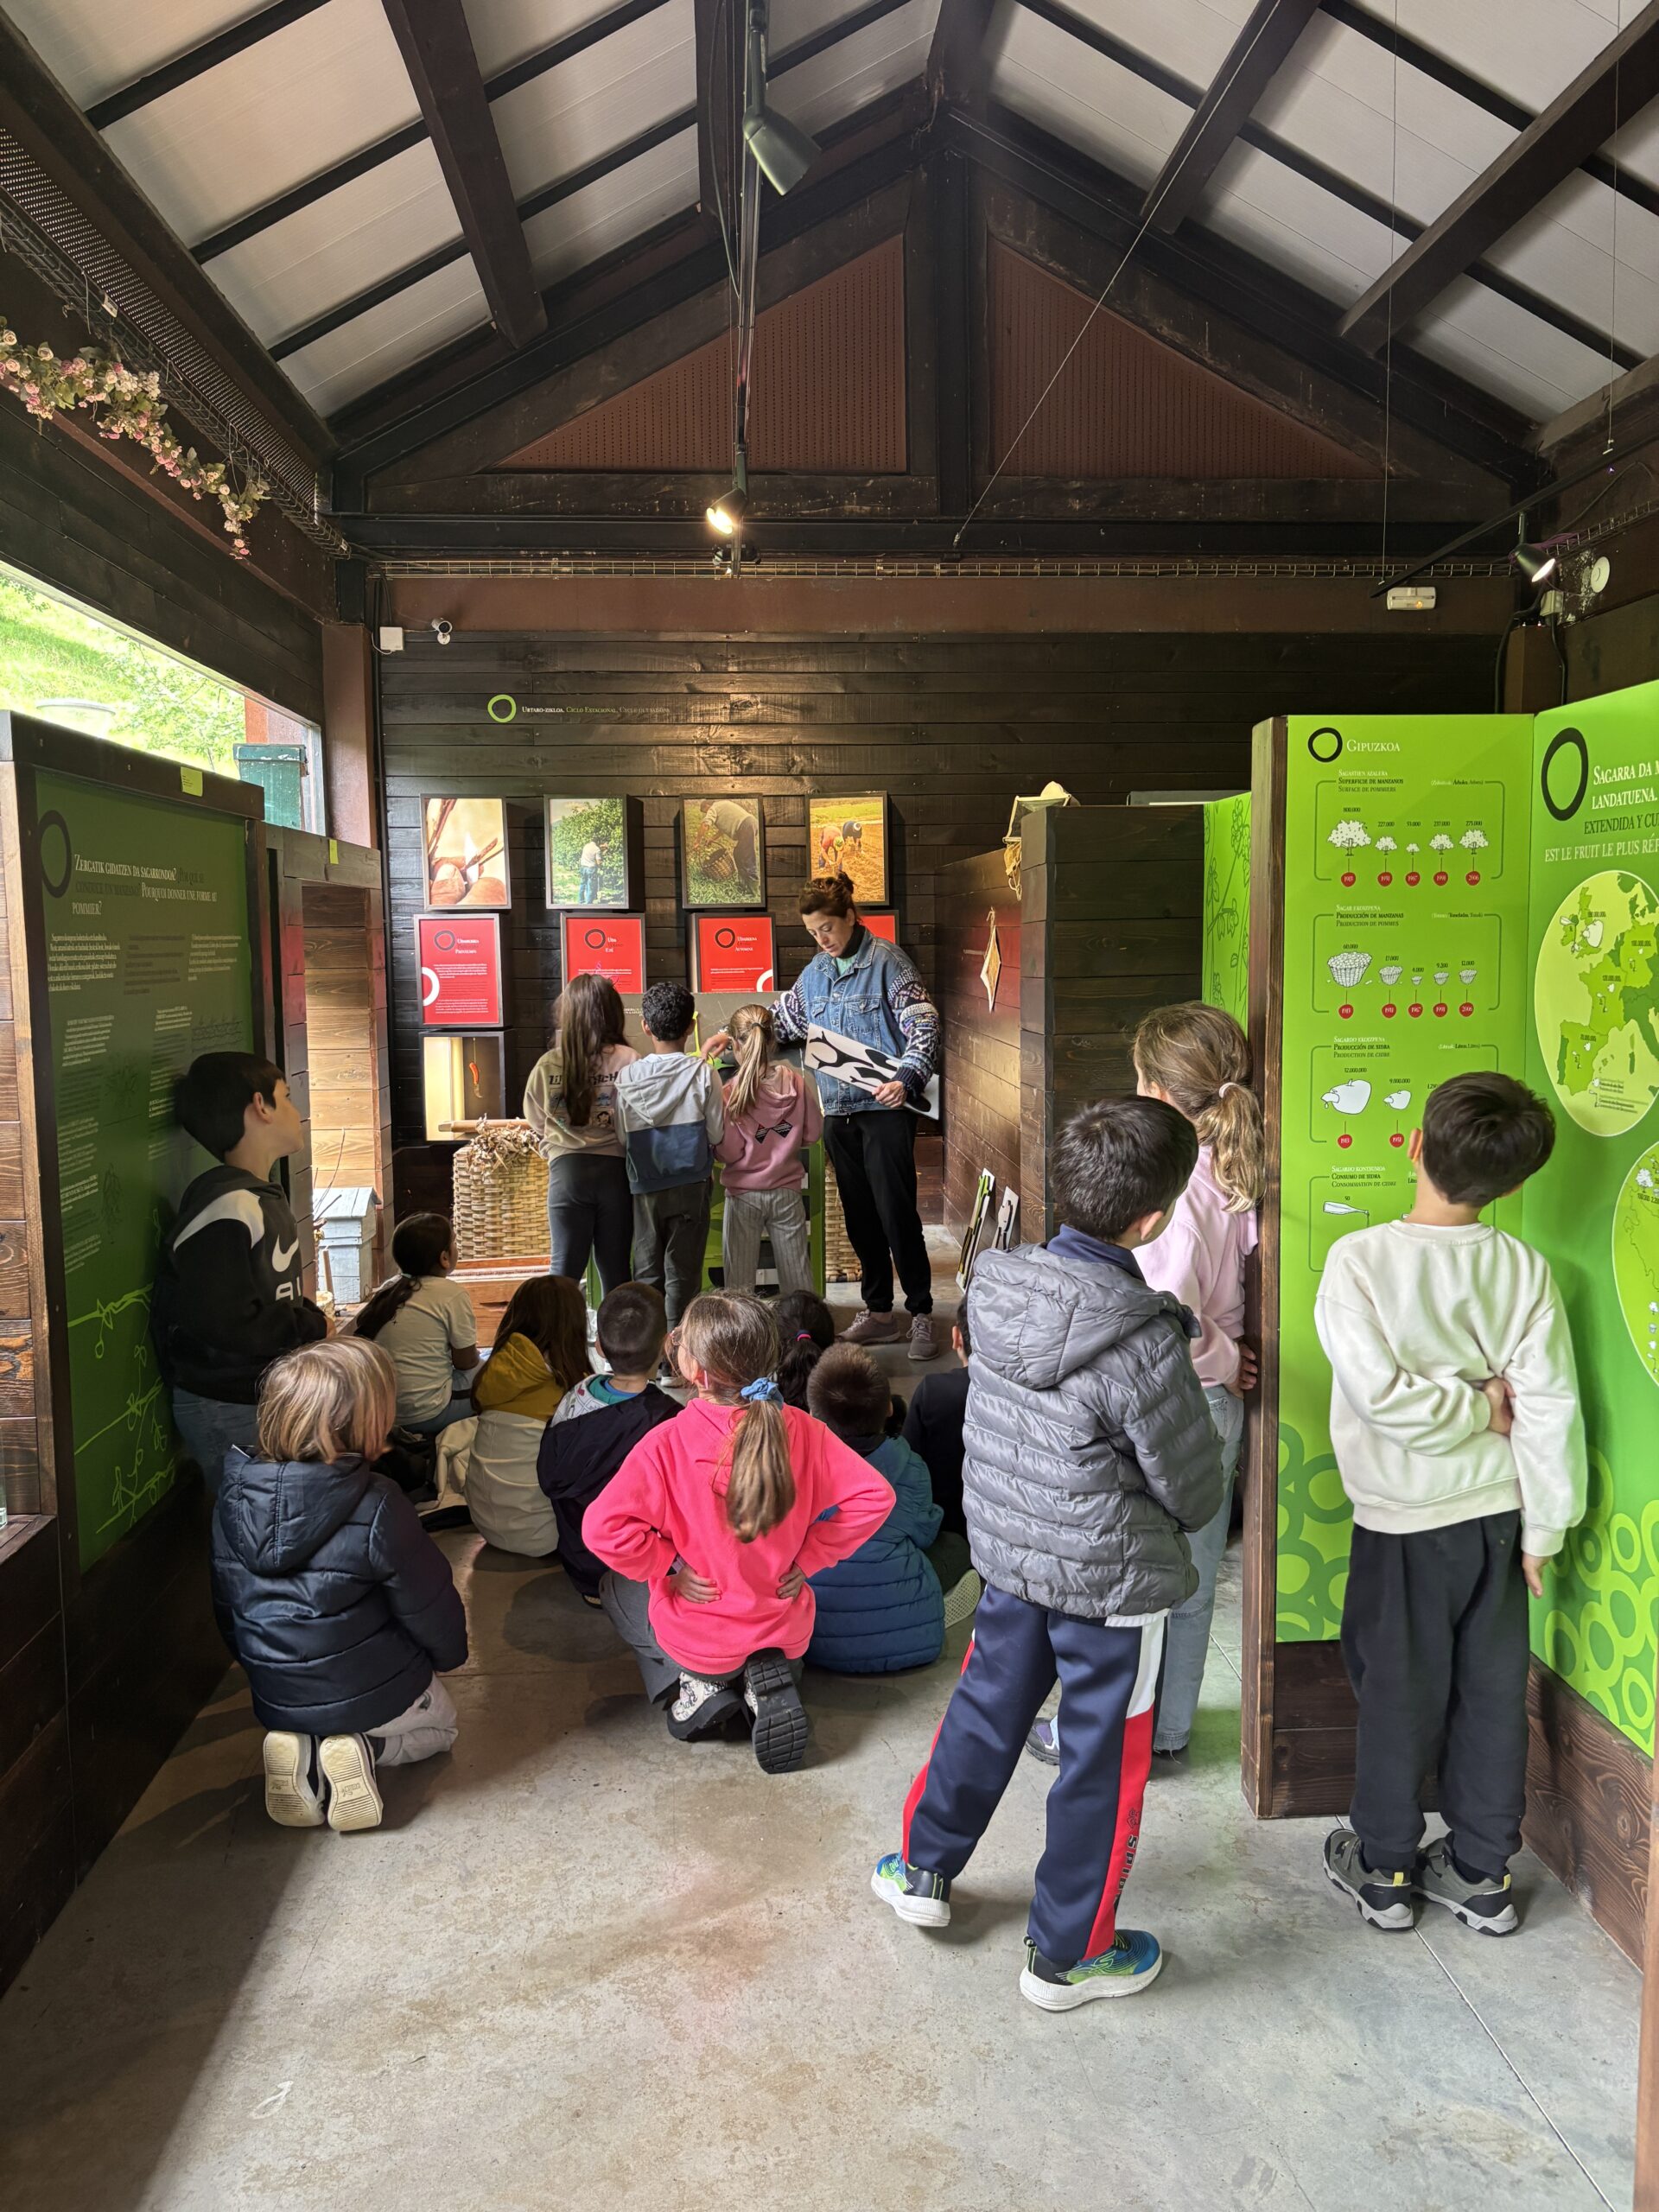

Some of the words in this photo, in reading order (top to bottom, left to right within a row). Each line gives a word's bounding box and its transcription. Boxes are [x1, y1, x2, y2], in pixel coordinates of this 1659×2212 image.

[1346, 739, 1401, 753] GIPUZKOA
[1593, 765, 1636, 785] SAGARRA
[1638, 761, 1652, 778] DA
[1592, 787, 1658, 810] LANDATUENA.
[1584, 816, 1635, 835] EXTENDIDA
[1637, 815, 1643, 829] Y
[1545, 848, 1560, 862] EST
[1561, 847, 1572, 861] LE
[1574, 844, 1600, 860] FRUIT
[1602, 843, 1613, 857] LE
[1616, 840, 1640, 856] PLUS
